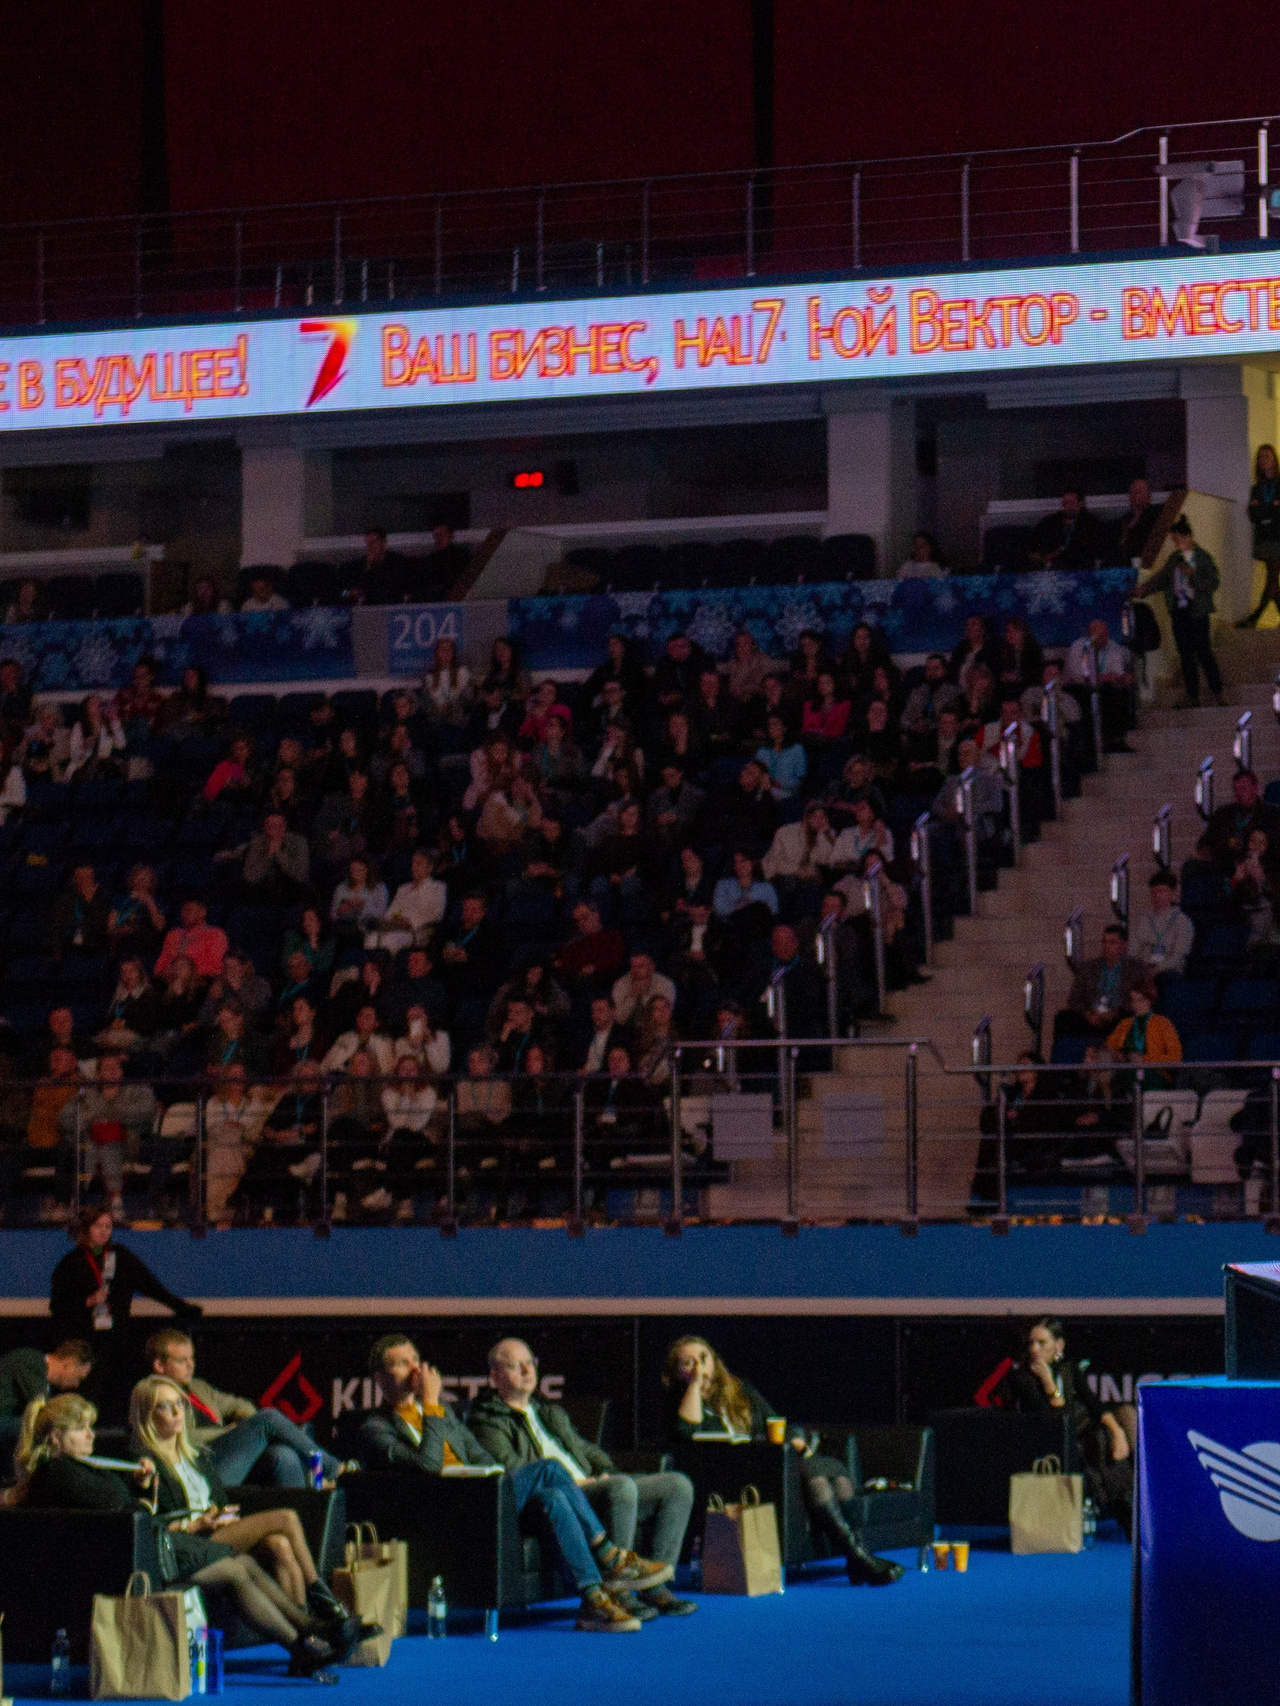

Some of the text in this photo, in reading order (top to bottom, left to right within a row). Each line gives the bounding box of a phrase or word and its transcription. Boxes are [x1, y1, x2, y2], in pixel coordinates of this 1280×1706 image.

[55, 333, 249, 417] БУДУЩЕЕ!
[382, 324, 477, 387] ВАШ
[490, 321, 659, 384] БИЗНЕС,
[909, 288, 1079, 354] ВЕКТОР
[393, 611, 458, 649] 204
